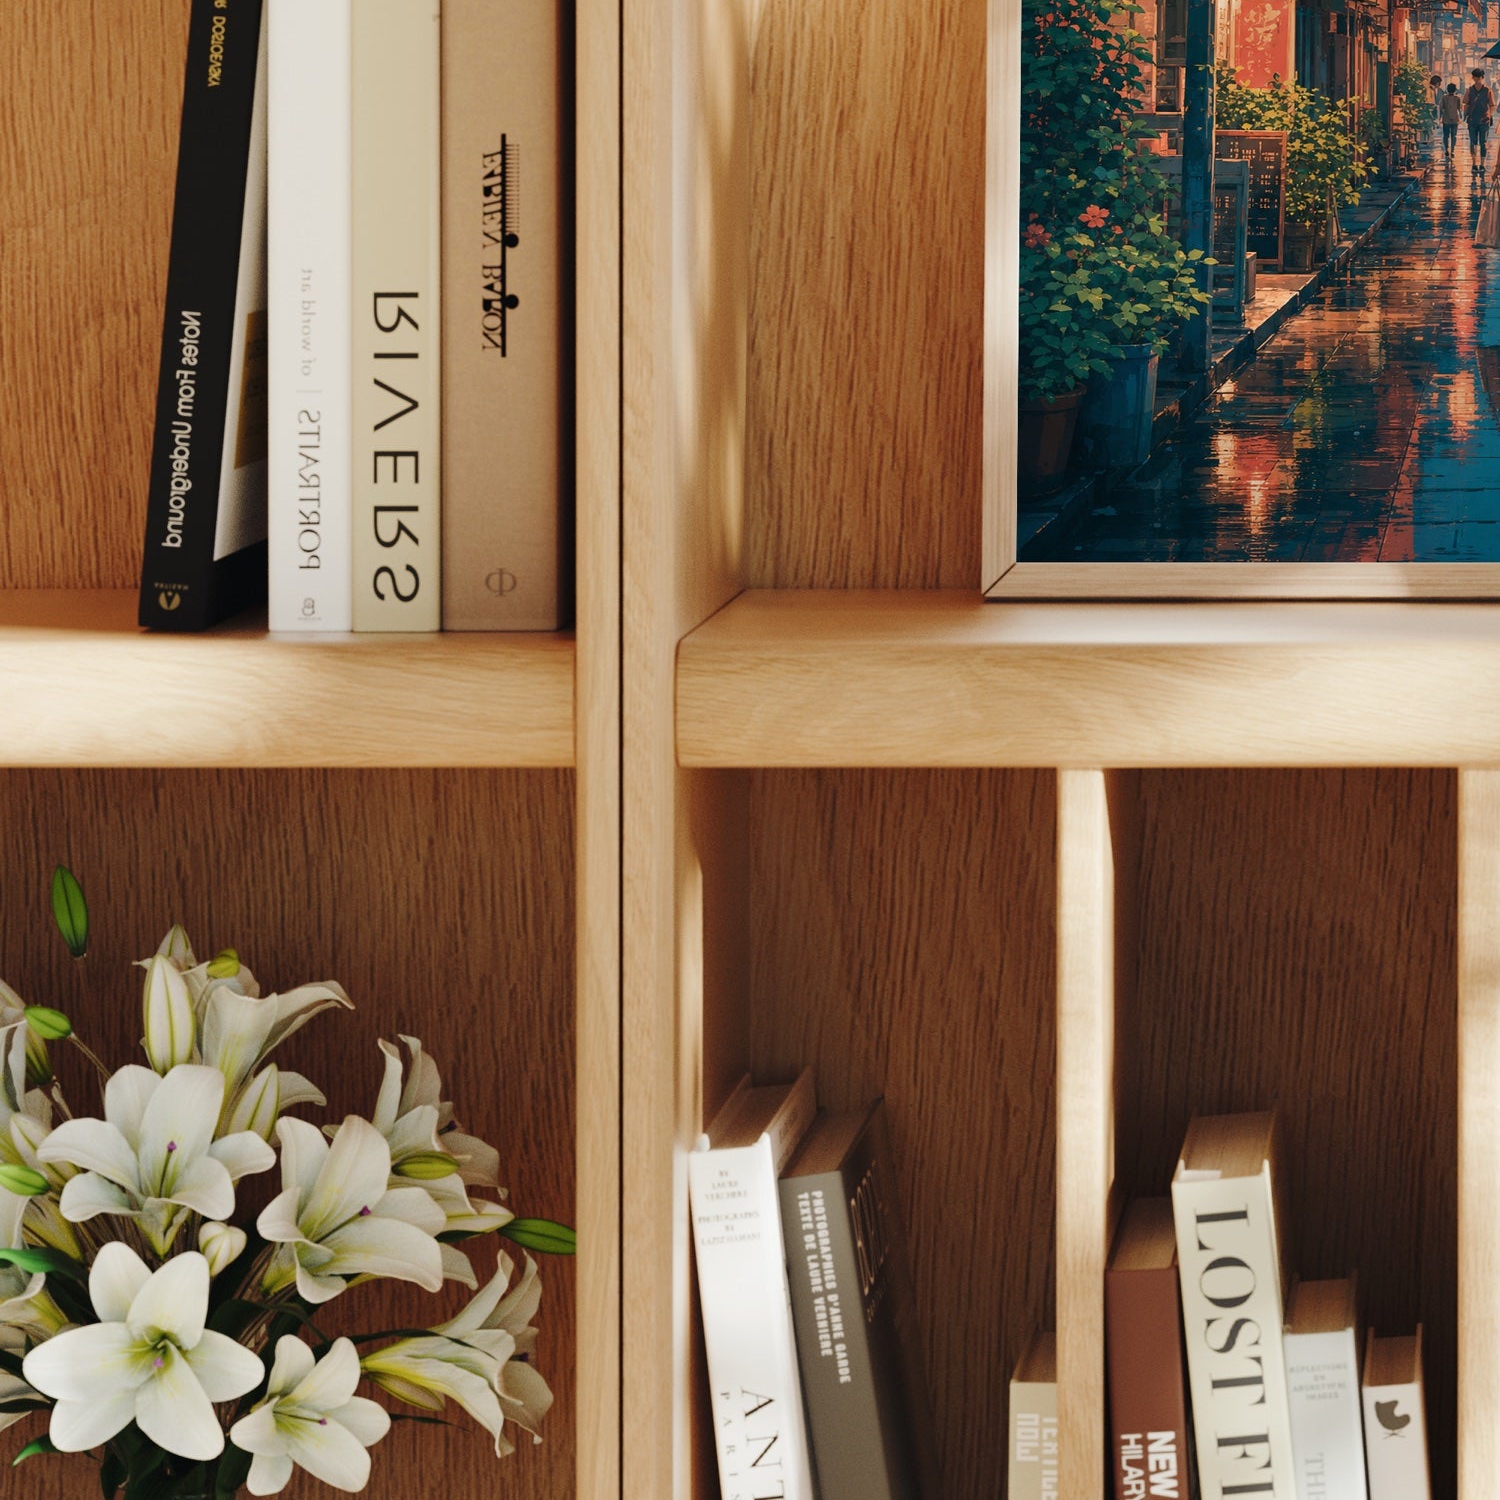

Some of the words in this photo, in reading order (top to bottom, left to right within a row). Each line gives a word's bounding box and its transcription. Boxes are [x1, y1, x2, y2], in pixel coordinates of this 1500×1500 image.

[797, 1191, 814, 1231] TEXTE
[803, 1234, 818, 1251] DE
[811, 1190, 838, 1291] PHOTOGRAPHIES
[806, 1254, 824, 1294] LAURE
[826, 1293, 845, 1340] D'ANNE
[1193, 1203, 1267, 1406] LOST
[834, 1343, 852, 1385] GARDE
[1146, 1430, 1179, 1499] NEW
